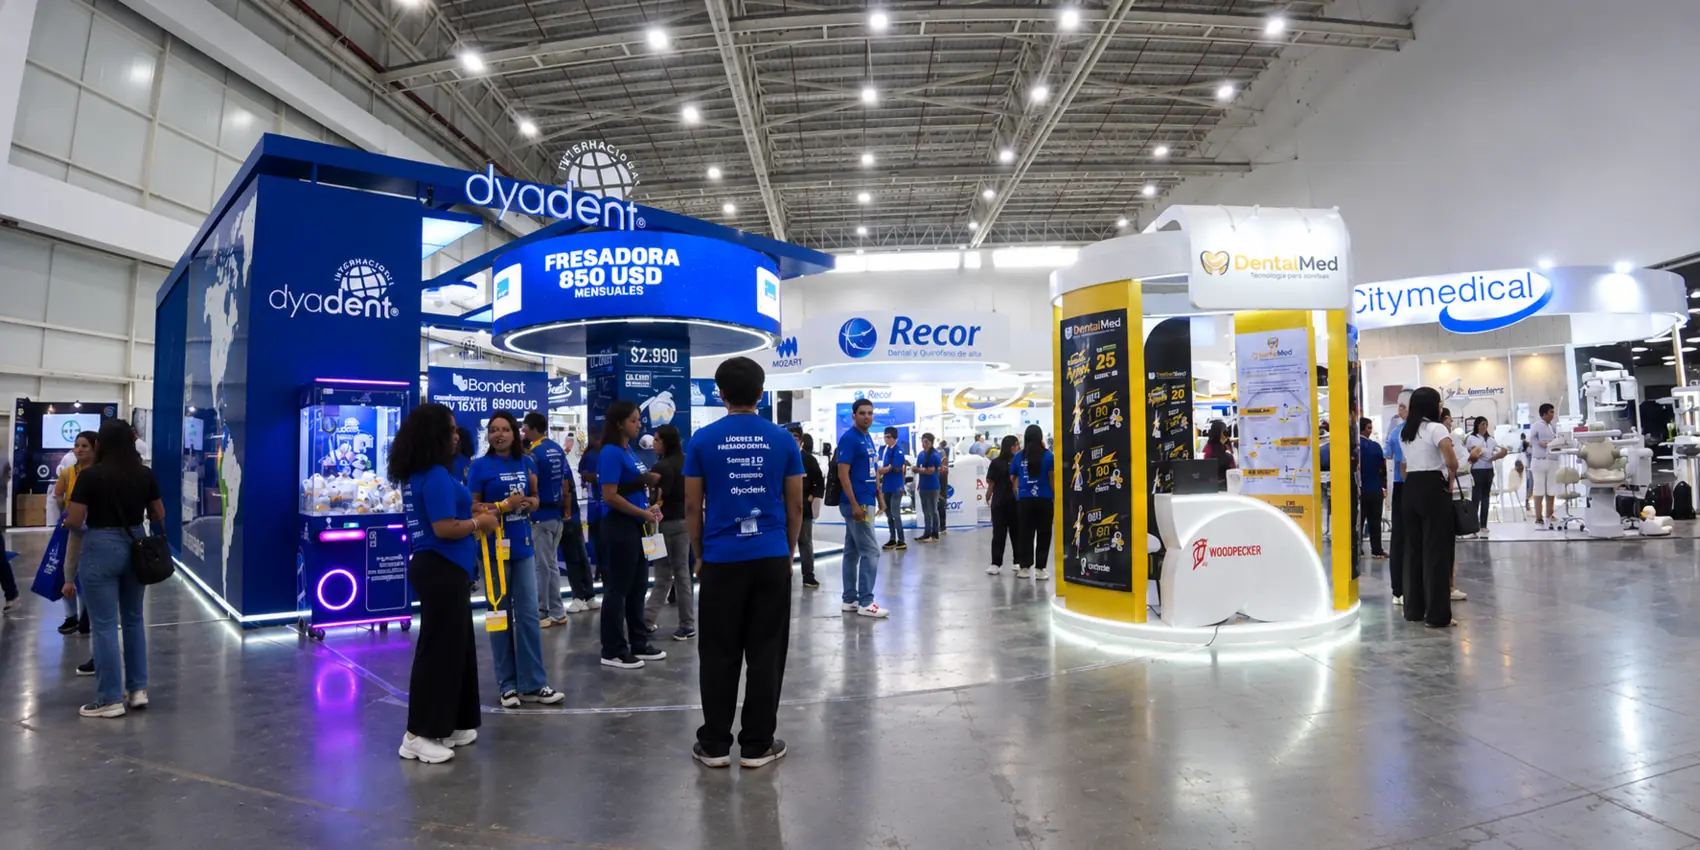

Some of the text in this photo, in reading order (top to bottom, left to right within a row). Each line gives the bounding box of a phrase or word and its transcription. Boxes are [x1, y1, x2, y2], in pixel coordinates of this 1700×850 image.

[545, 247, 680, 271] FRESADORA
[1235, 255, 1338, 271] DentalMed
[559, 266, 663, 289] 850 USD
[574, 285, 644, 298] MENSUALES
[1354, 272, 1534, 316] Citymedical
[889, 316, 981, 347] Recor
[1074, 317, 1121, 335] DentalMed
[1096, 351, 1116, 370] 25
[468, 378, 526, 394] Bondent
[868, 390, 892, 399] Recor
[1171, 388, 1185, 401] 20
[1209, 545, 1262, 557] WOODPECKER
